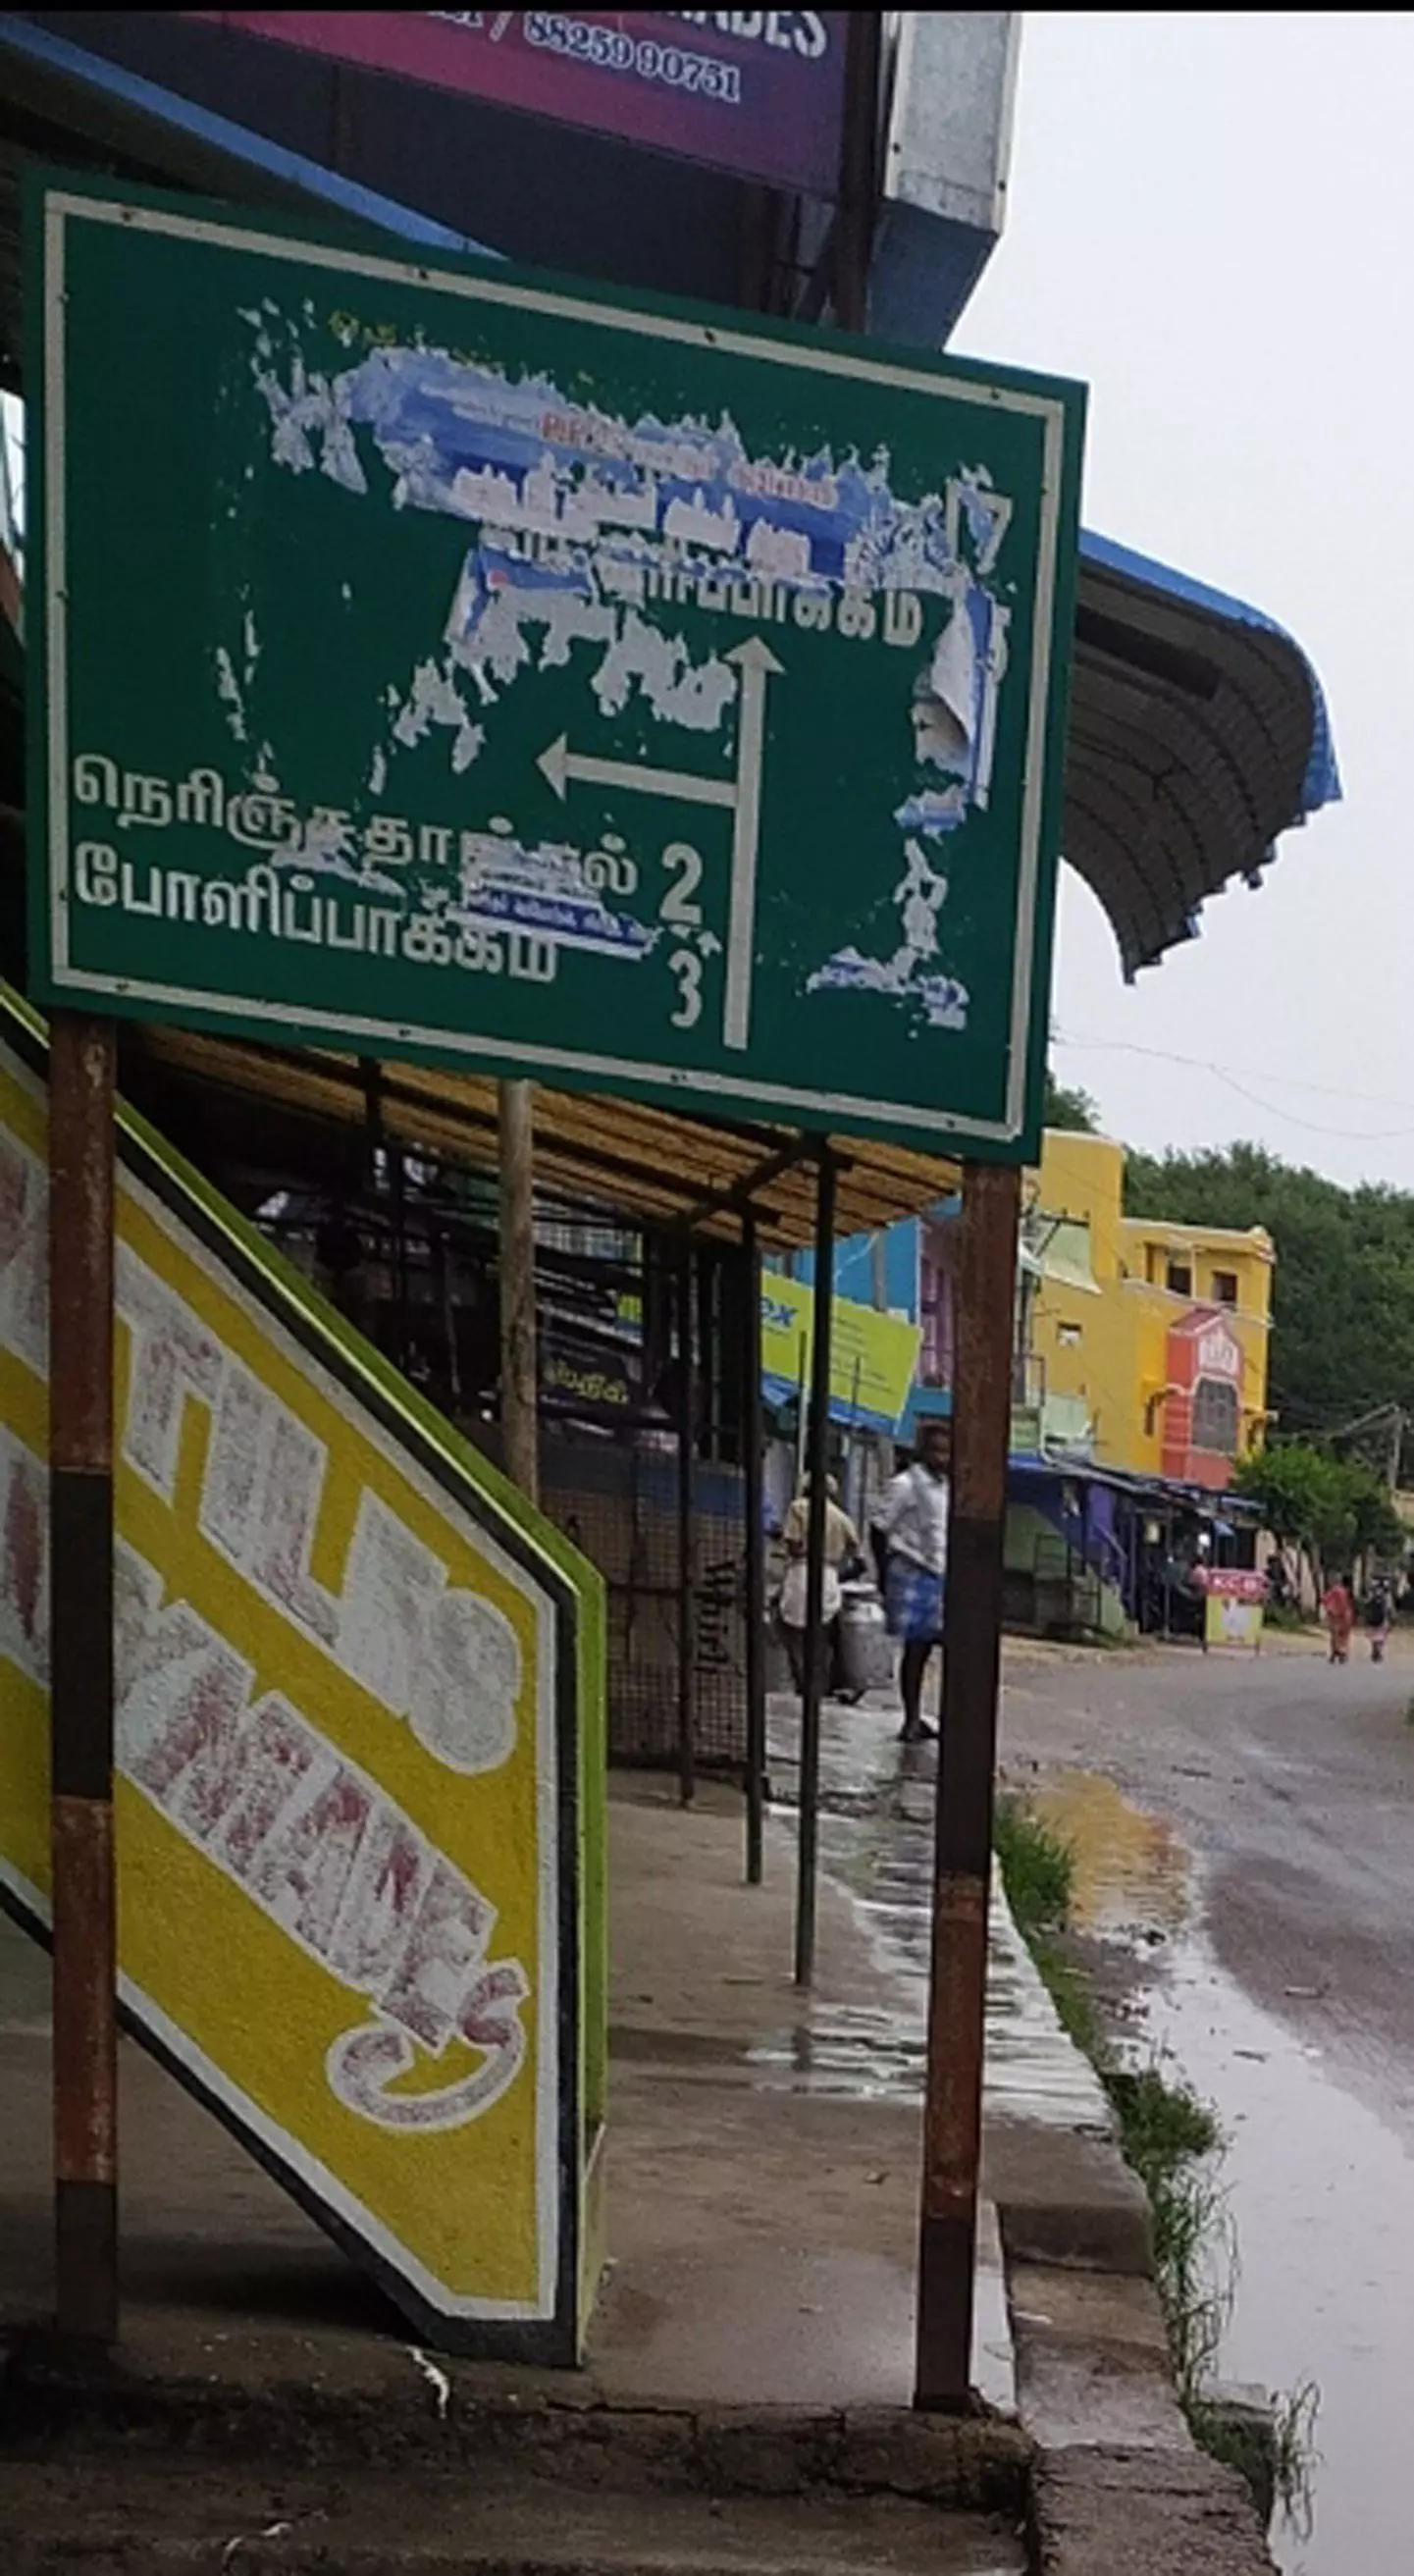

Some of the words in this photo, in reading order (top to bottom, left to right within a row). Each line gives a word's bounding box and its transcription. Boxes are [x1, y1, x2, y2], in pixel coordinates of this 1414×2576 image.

[523, 11, 634, 69] 88259
[637, 40, 740, 103] 90751
[658, 841, 703, 924] 2
[667, 949, 703, 1027] 3
